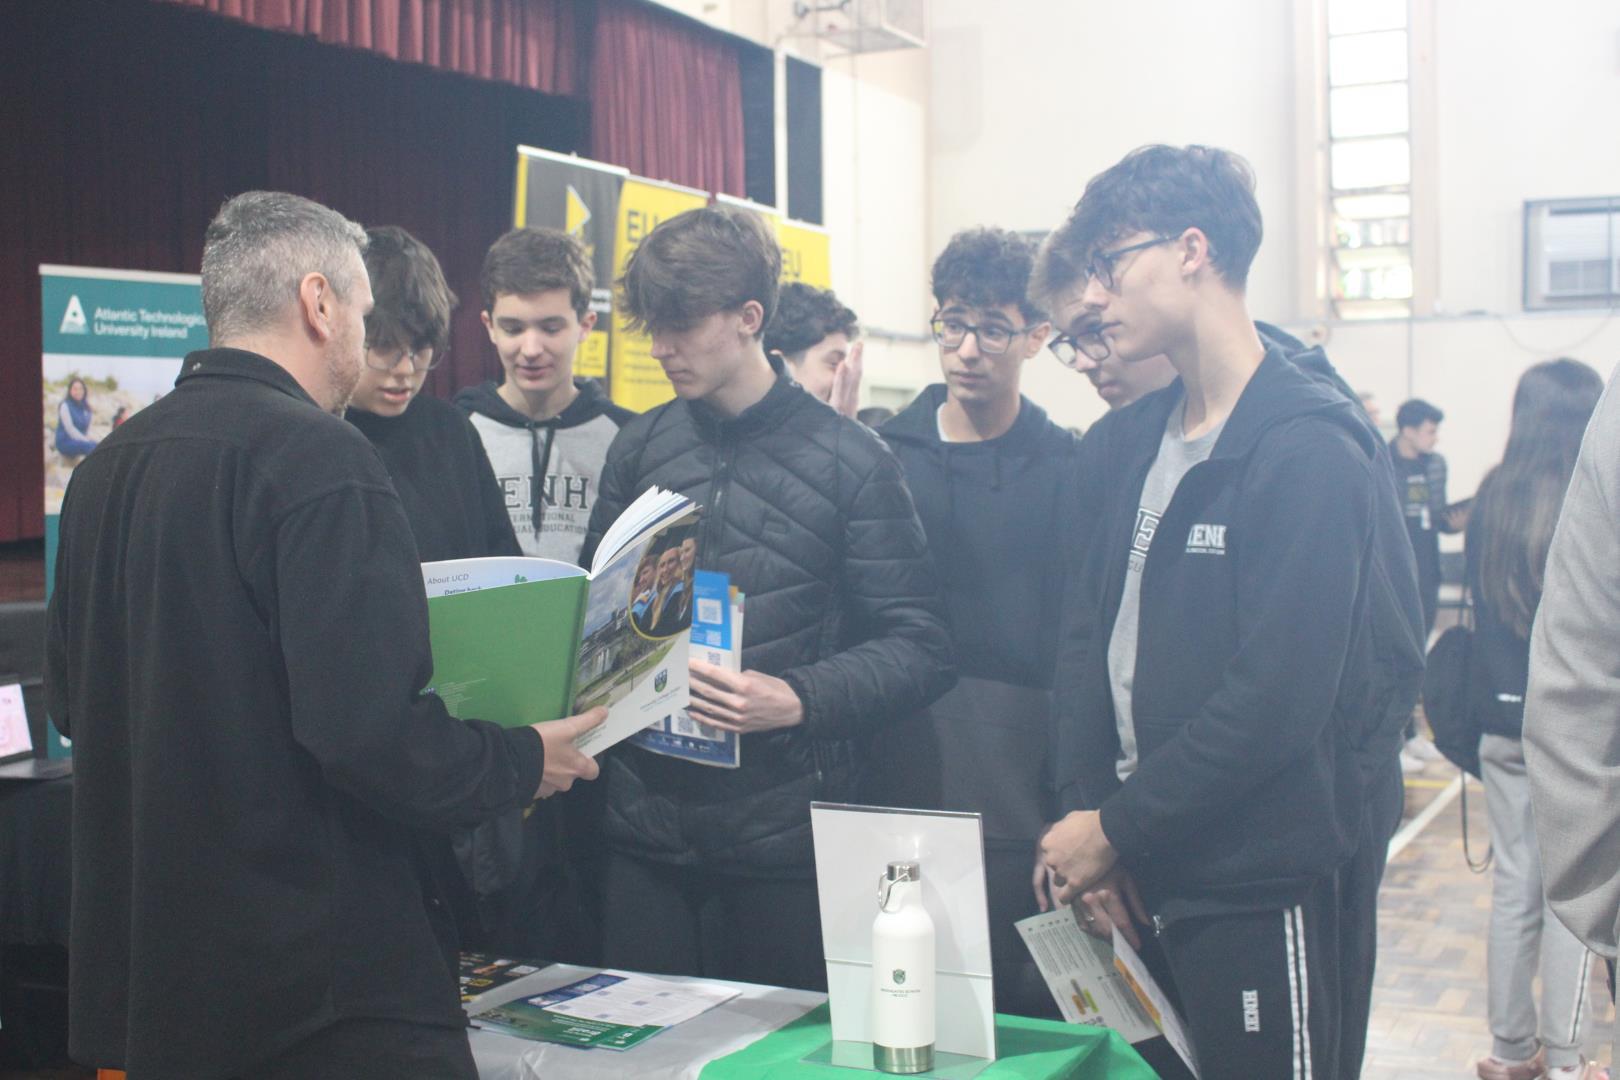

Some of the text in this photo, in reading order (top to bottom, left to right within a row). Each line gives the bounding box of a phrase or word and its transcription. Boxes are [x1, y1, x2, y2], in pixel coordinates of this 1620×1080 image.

[94, 307, 137, 322] Atlantic
[94, 322, 188, 340] University Ireland
[427, 573, 470, 585] About UCD
